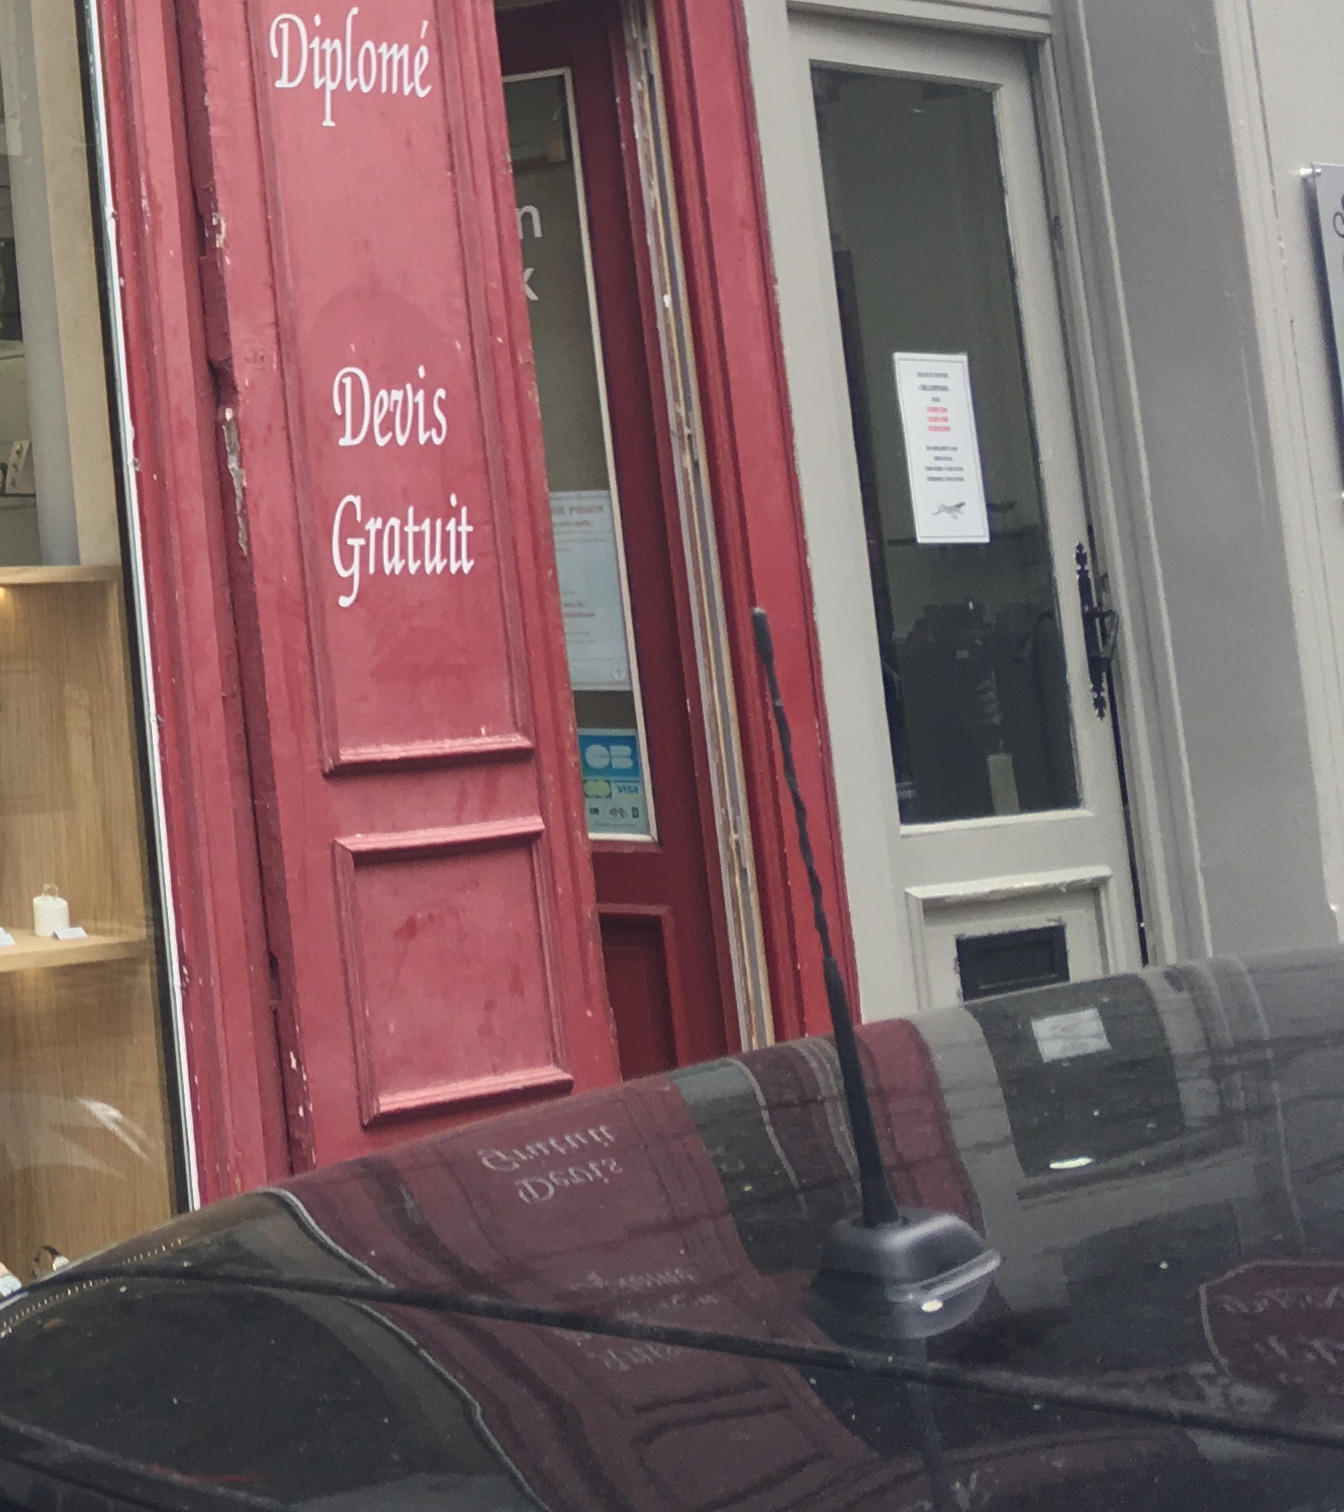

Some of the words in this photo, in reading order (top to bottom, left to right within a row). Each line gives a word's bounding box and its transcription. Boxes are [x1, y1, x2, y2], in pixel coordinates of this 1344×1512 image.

[269, 6, 432, 127] Diplomé
[333, 366, 448, 447] Devis
[332, 492, 474, 607] Gratuit
